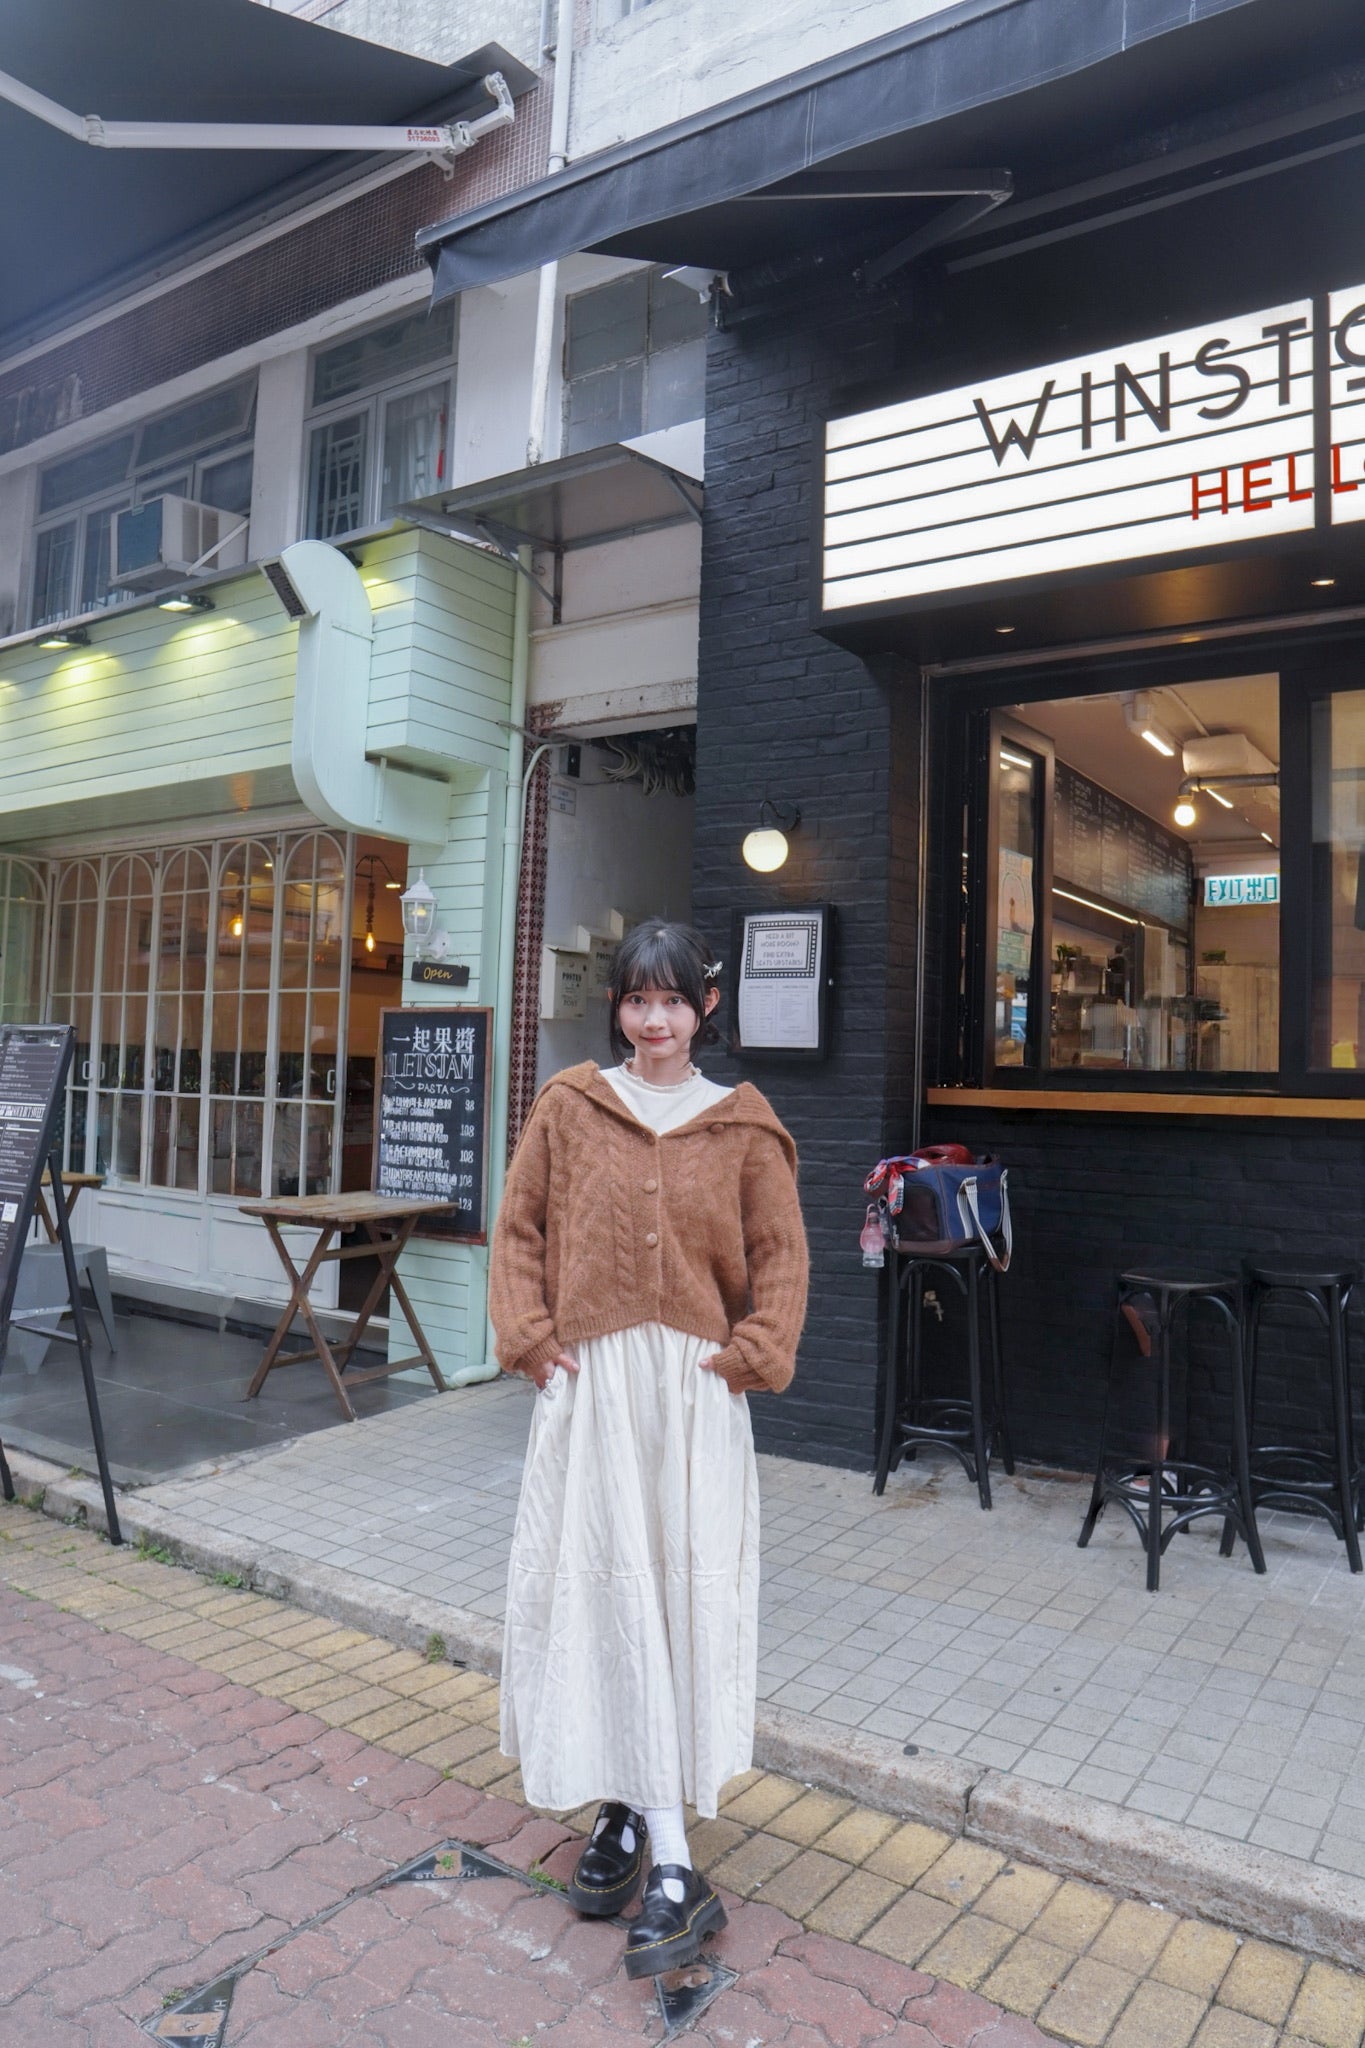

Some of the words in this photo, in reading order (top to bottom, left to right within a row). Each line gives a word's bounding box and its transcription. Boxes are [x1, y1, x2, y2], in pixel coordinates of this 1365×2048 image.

[1192, 445, 1365, 520] HELL
[1208, 878, 1243, 901] EXIT
[1247, 877, 1277, 901] 出口
[423, 966, 452, 981] Open
[392, 1026, 475, 1053] 一起果醬
[418, 1083, 449, 1094] PASTA
[461, 1125, 475, 1137] 108
[460, 1150, 474, 1163] 108
[458, 1198, 473, 1210] 128
